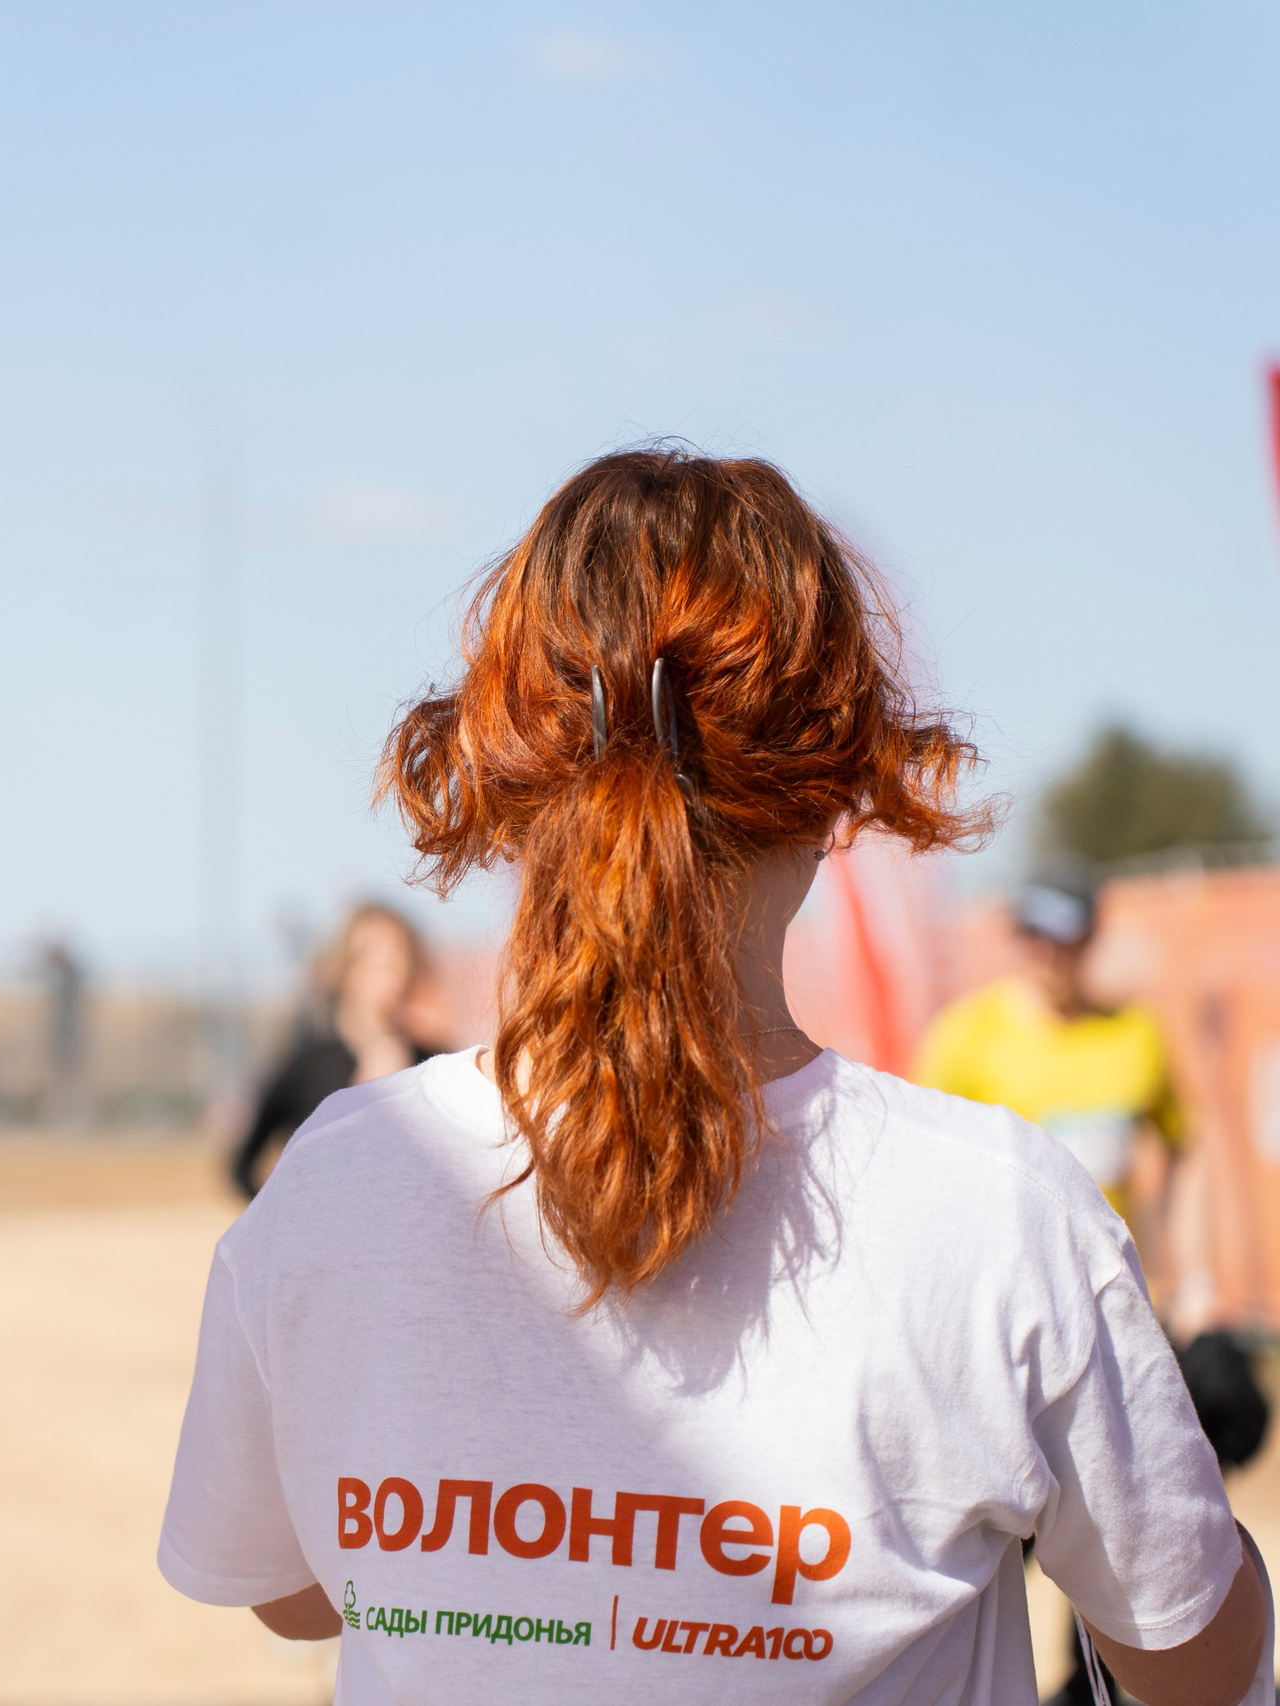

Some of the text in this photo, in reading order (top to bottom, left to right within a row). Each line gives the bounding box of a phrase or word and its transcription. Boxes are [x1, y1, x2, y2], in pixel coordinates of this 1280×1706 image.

[337, 1476, 852, 1605] волонтер
[365, 1606, 592, 1646] САДЫ ПРИДОНЬЯ
[631, 1616, 834, 1661] ULTRA100
